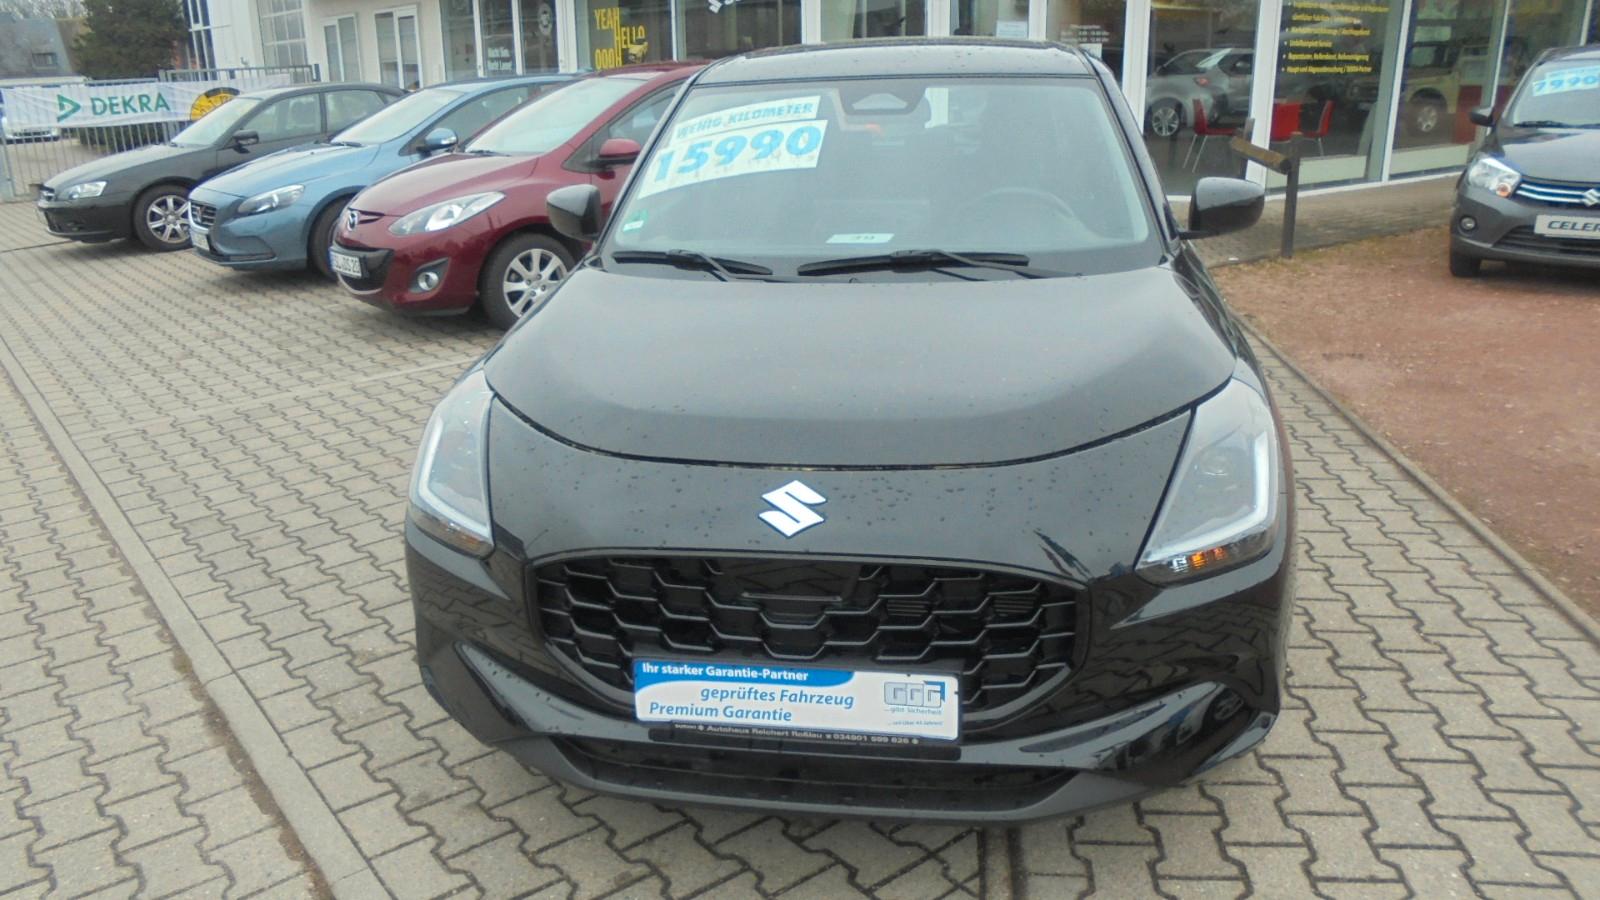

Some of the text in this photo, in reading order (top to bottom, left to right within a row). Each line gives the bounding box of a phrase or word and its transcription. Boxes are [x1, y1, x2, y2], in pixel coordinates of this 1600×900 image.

[594, 7, 620, 30] YEAH
[91, 92, 171, 117] DEKRA
[677, 102, 813, 139] WENIG KILOMETER
[655, 125, 822, 183] 15990
[642, 662, 809, 681] Ihr starker Garantie-Partner
[700, 686, 855, 709] geprüftes Fahrzeug
[649, 701, 792, 722] Premium Garantie
[706, 725, 750, 735] Autohaus
[752, 728, 789, 738] Reichert
